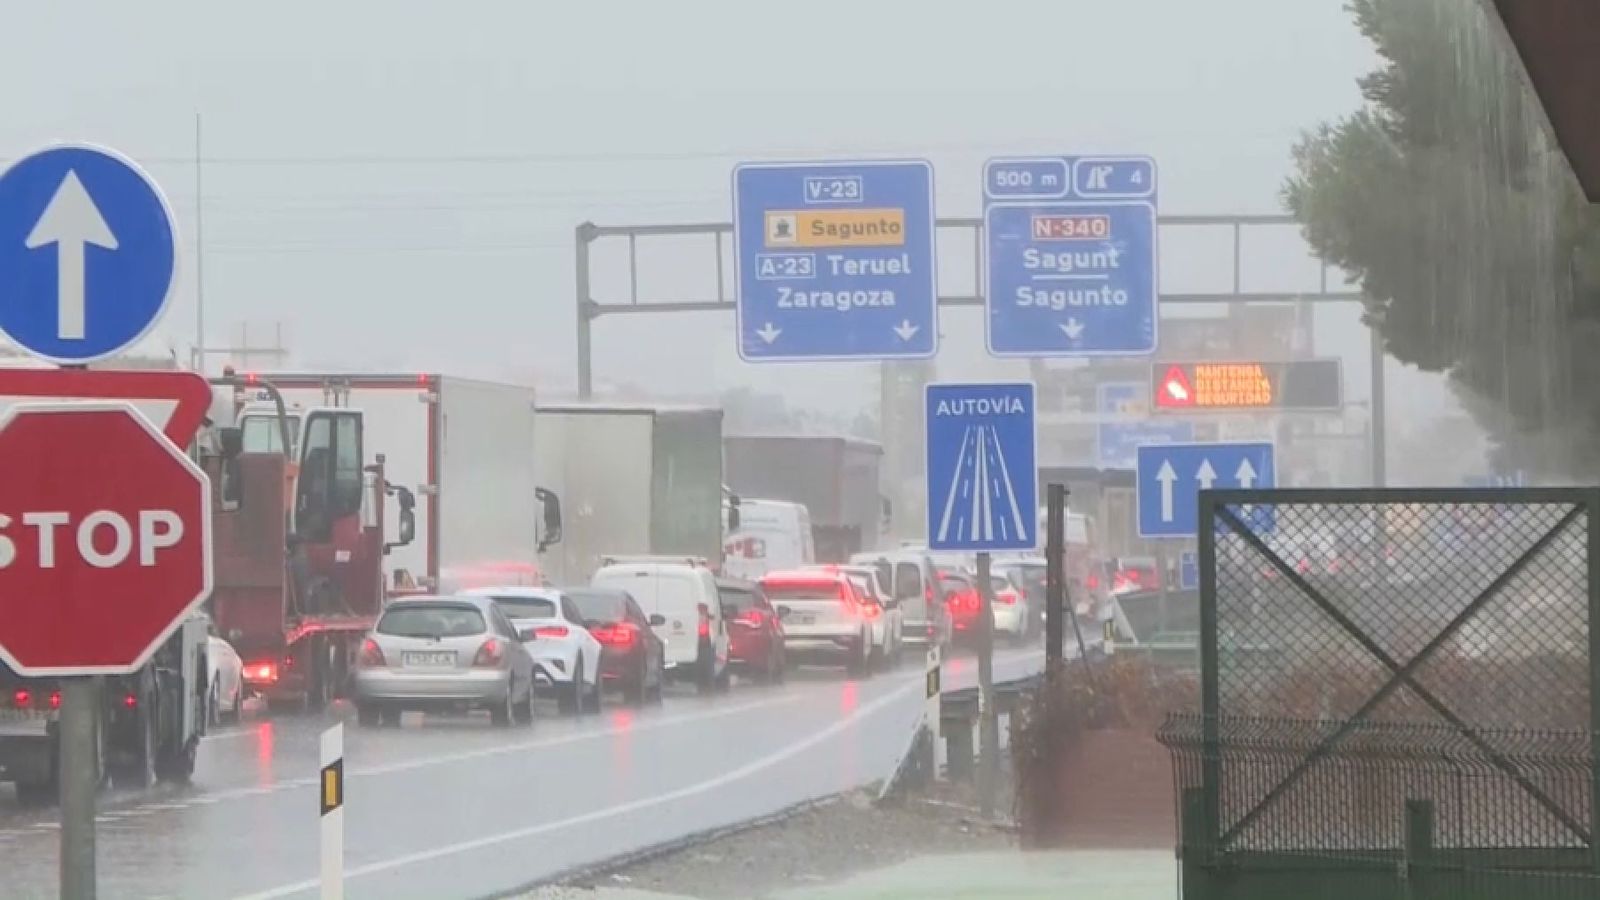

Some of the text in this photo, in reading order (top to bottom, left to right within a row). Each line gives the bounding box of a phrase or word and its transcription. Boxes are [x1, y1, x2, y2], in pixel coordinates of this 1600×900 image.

[996, 170, 1057, 186] 500 m
[1130, 168, 1142, 184] 4
[809, 181, 858, 198] V-23
[811, 218, 901, 239] Sagunto
[1035, 218, 1106, 236] N-340
[760, 253, 912, 276] A-23 Teruel
[1022, 248, 1120, 272] Sagunt
[777, 286, 896, 311] Zaragoza
[1015, 284, 1129, 310] Sagunto
[936, 395, 1025, 416] AUTOVÍA
